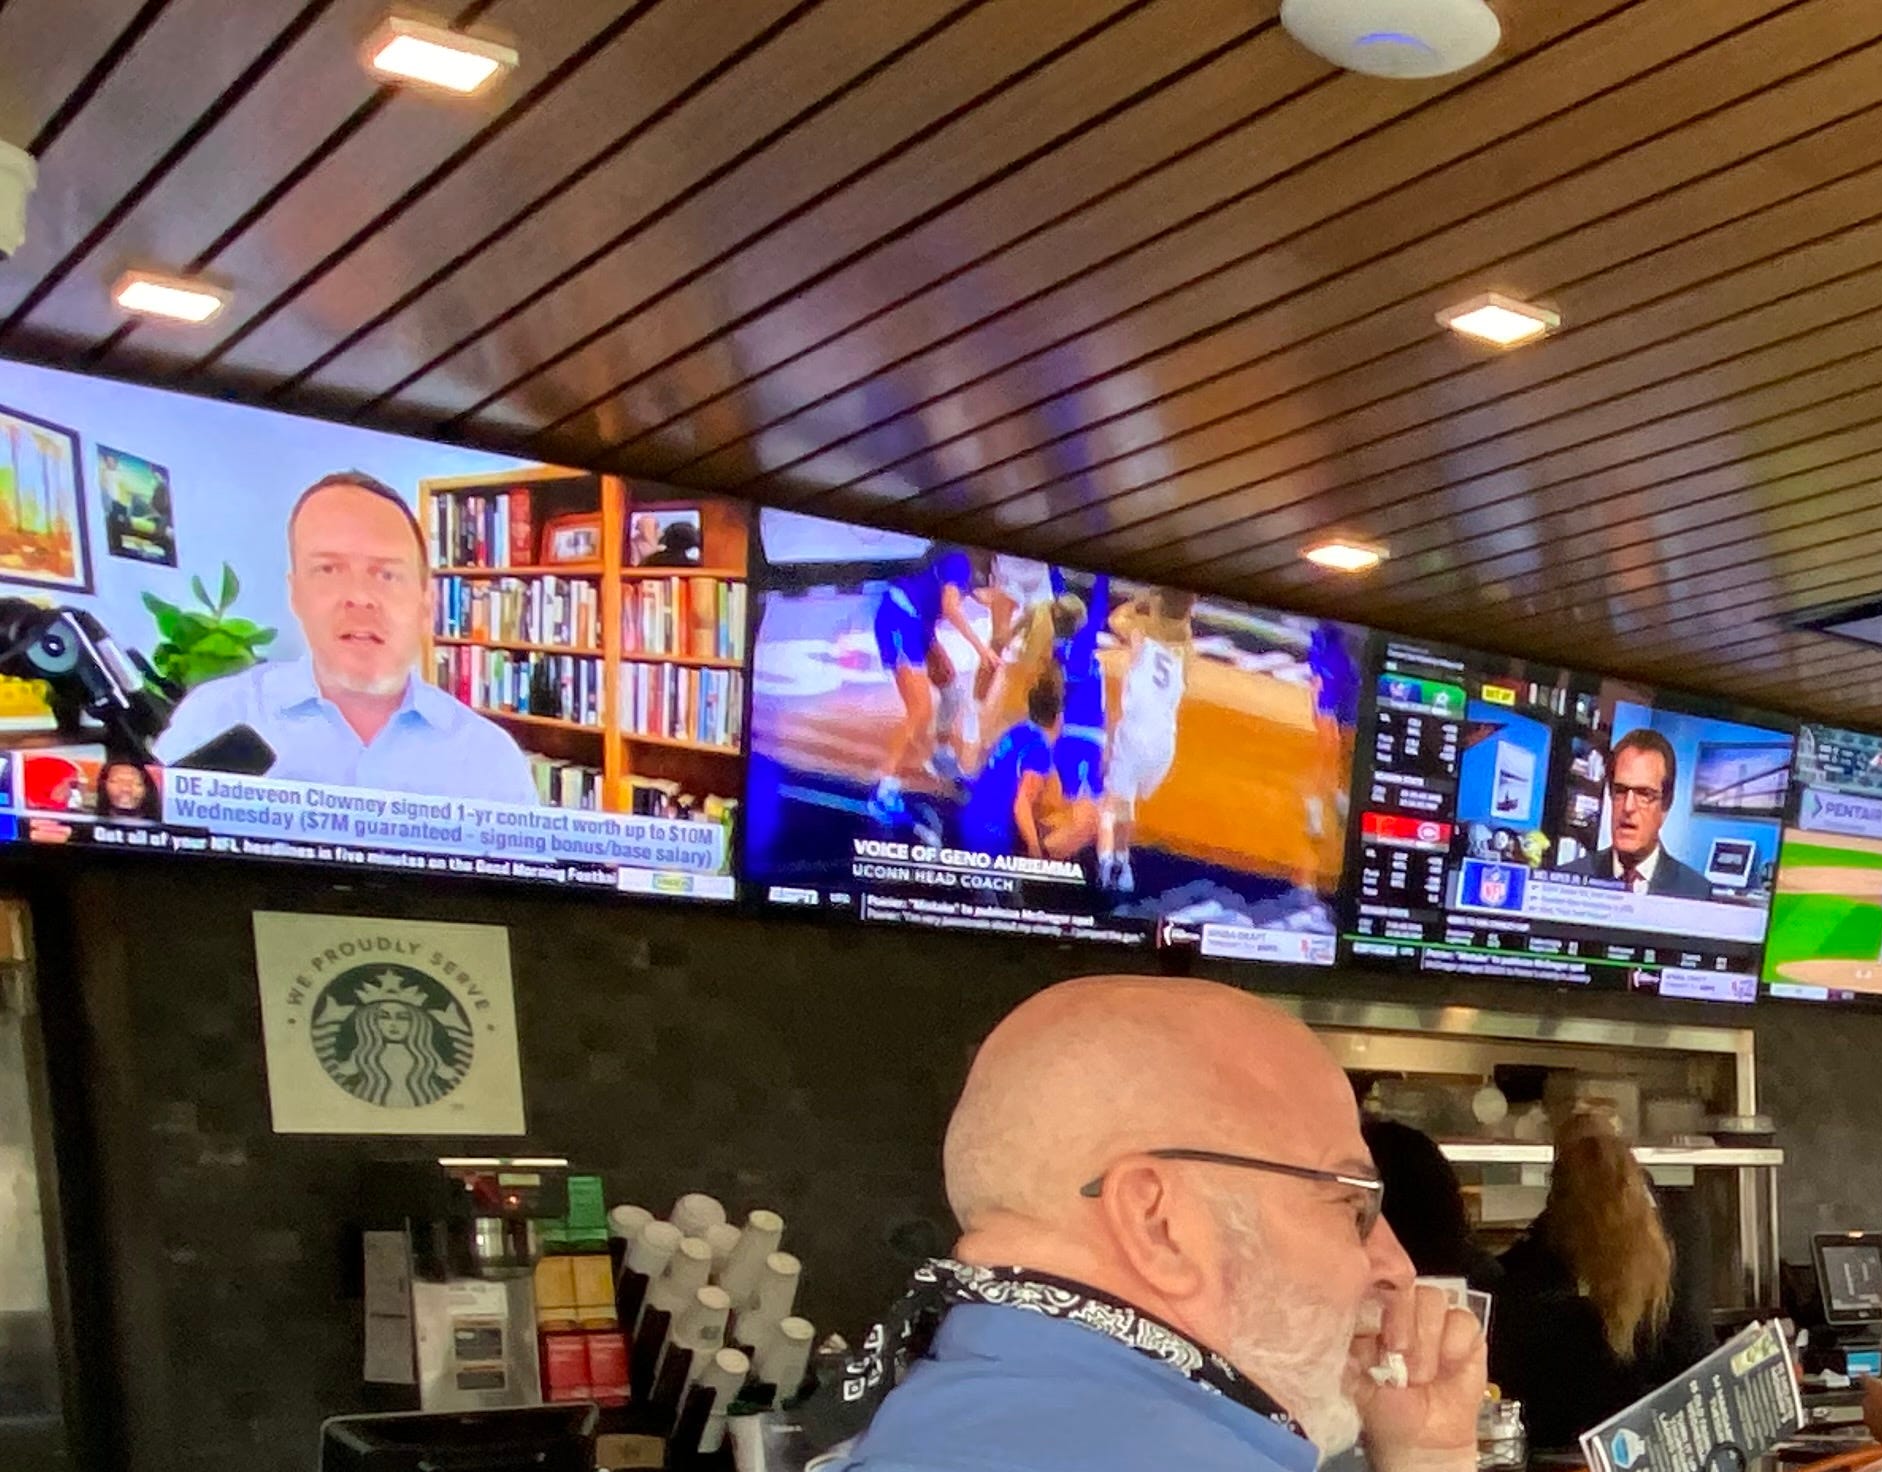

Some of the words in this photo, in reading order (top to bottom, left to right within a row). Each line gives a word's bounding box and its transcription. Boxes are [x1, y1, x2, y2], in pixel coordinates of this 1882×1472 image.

[1152, 651, 1172, 689] 5
[175, 775, 202, 796] DE
[207, 779, 301, 805] Jadeveon
[306, 788, 386, 817] Clowney
[391, 798, 451, 820] signed
[457, 804, 492, 826] 1-yr
[497, 808, 569, 832] contract
[573, 817, 620, 836] worth
[625, 823, 645, 841] up
[649, 823, 664, 839] to
[669, 825, 713, 845] $10M
[1825, 802, 1882, 820] PENTAIR
[175, 797, 294, 831] Wednesday
[300, 811, 349, 832] ($7M
[355, 818, 463, 843] guaranteed
[480, 829, 546, 850] signing
[551, 835, 650, 860] bonus/base
[655, 847, 713, 869] salary)
[852, 863, 910, 881] UCONN
[914, 868, 957, 886] HEAD
[960, 873, 1014, 892] COACH
[853, 838, 909, 859] VOICE
[911, 844, 937, 862] OF
[940, 848, 991, 868] GENO
[993, 855, 1084, 879] AURIEMMA
[286, 975, 313, 1006] WE
[310, 935, 422, 972] PROUDLY
[429, 951, 491, 1011] SERVE
